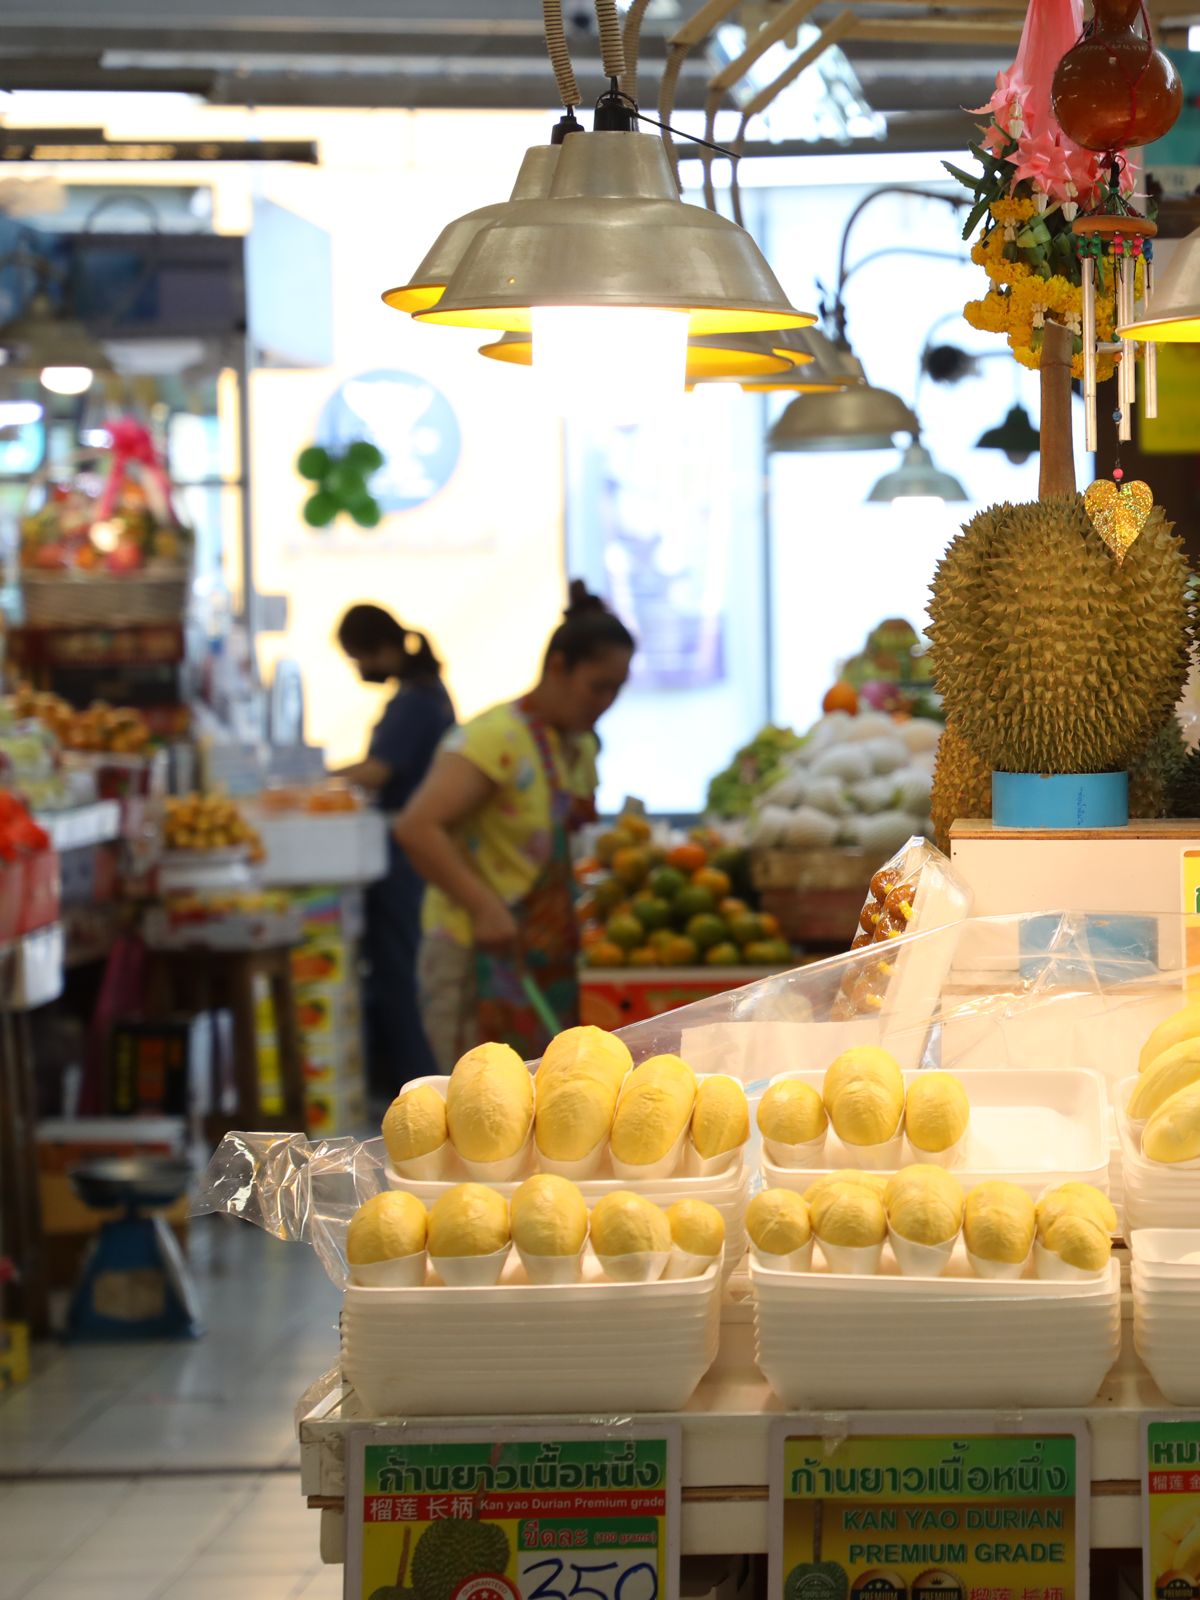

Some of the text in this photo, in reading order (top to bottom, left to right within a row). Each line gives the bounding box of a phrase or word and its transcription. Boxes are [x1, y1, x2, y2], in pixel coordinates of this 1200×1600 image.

[378, 1442, 661, 1492] ก้านยาวเนื้อหนึ่ง
[790, 1442, 1068, 1494] ก้านยาวเนื้อหนึ่ง
[1153, 1474, 1184, 1490] 榴莲
[370, 1495, 665, 1521] 榴莲 长柄 Kan yao Durian Premium grade
[843, 1508, 1065, 1530] KAN YAO DURIAN
[522, 1521, 588, 1548] ขีดละ
[848, 1542, 1065, 1564] PREMIUM GRADE
